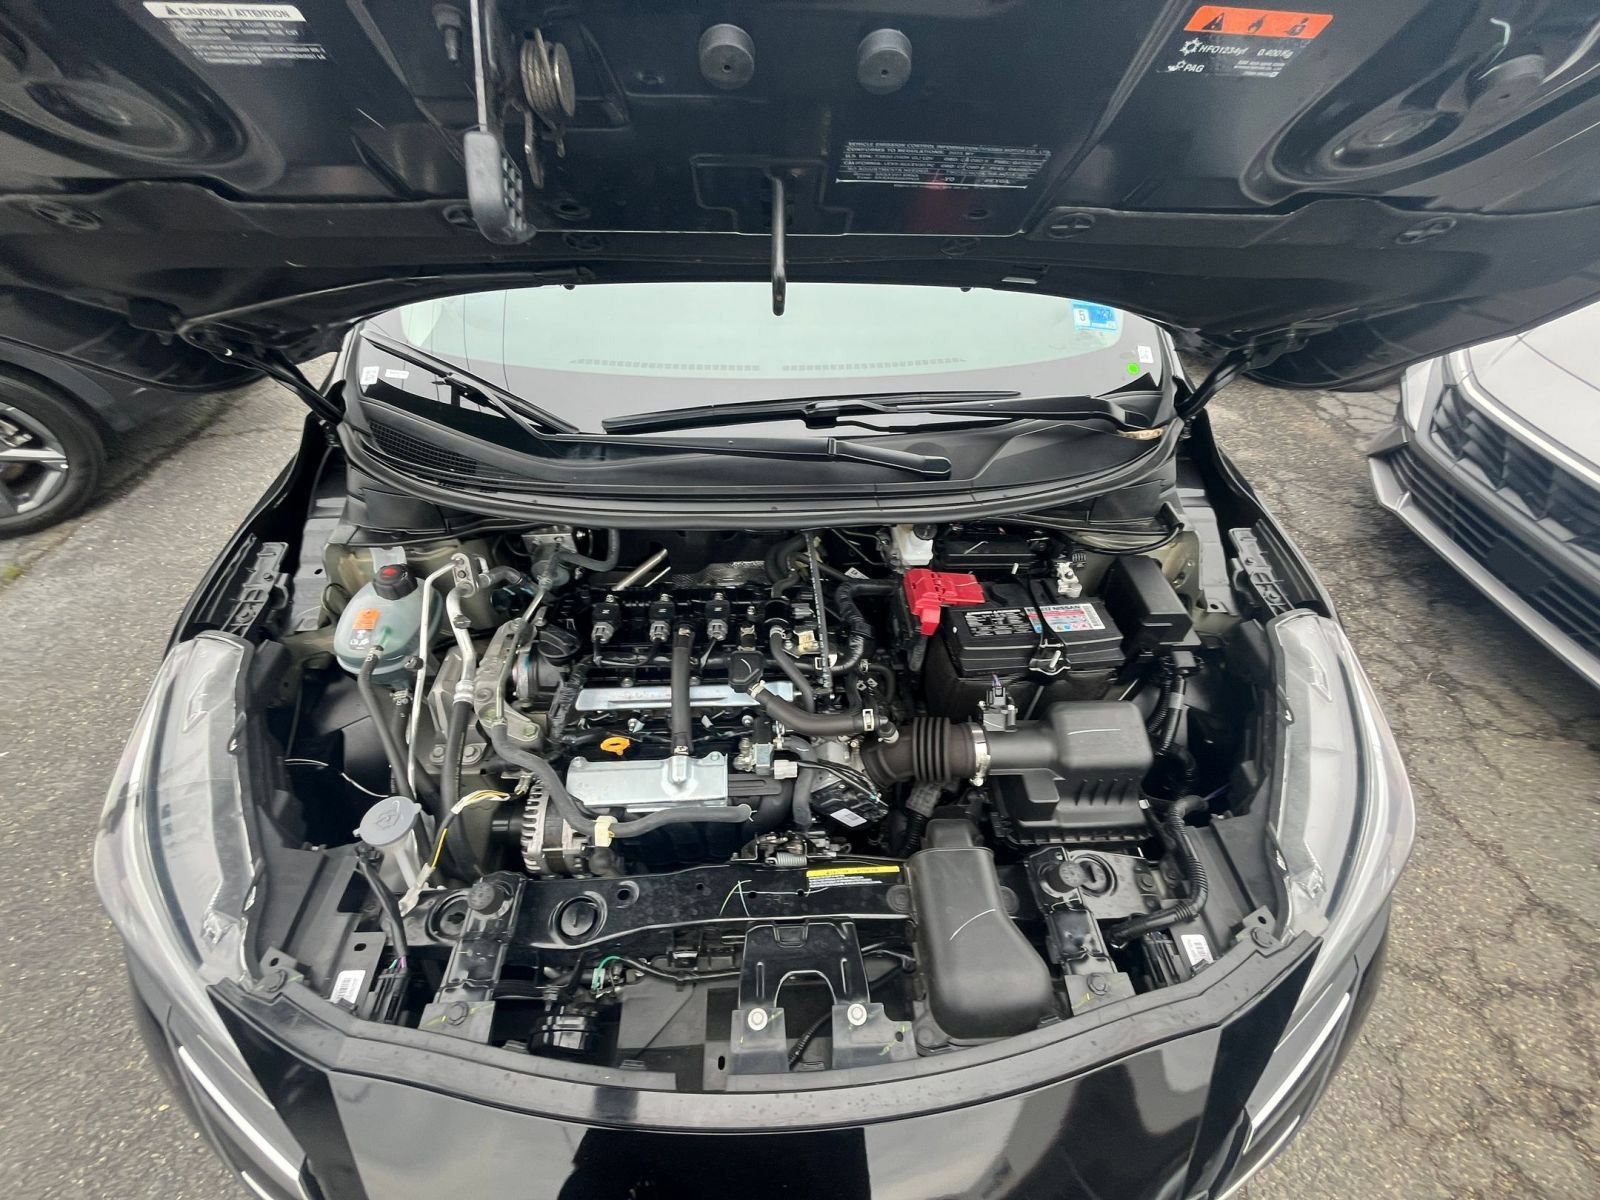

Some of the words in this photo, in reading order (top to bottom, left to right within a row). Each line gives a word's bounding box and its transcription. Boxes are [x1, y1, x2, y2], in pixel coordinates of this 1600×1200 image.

[179, 7, 224, 17] CAUTION
[234, 8, 290, 18] ATTENTION
[1183, 63, 1205, 73] PAG
[1079, 310, 1086, 322] 5
